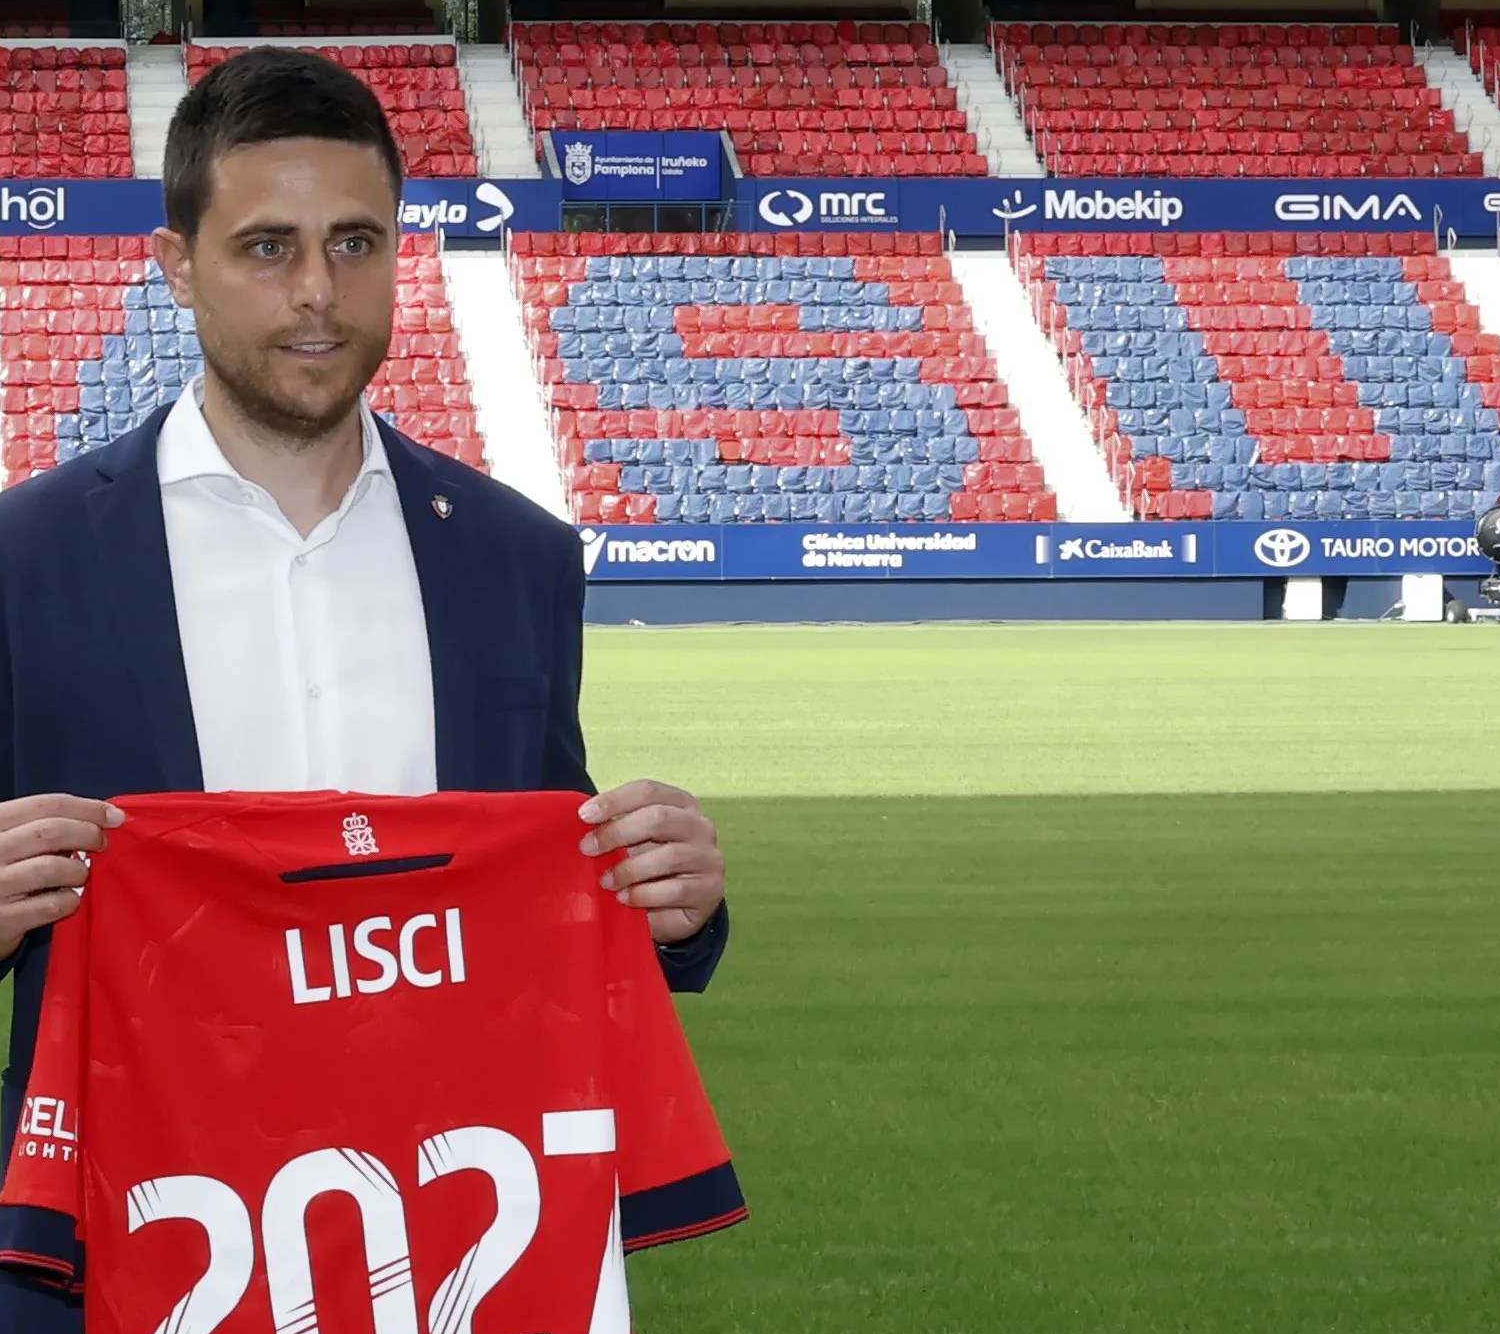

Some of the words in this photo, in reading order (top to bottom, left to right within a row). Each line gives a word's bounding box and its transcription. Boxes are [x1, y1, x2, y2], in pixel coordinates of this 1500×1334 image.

[595, 165, 654, 176] Pamplona
[662, 155, 707, 167] Iruñeko
[397, 199, 468, 228] aylo
[820, 192, 885, 214] mrc
[1045, 191, 1182, 225] Mobekip
[1275, 195, 1421, 221] GIMA
[607, 538, 715, 562] macron
[802, 533, 865, 551] Clínica
[866, 533, 977, 551] Universidad
[1085, 540, 1172, 558] CaixaBank
[1321, 537, 1394, 557] TAURO
[1400, 537, 1480, 557] MOTOR
[802, 551, 824, 568] de
[827, 552, 902, 568] Navarra
[285, 908, 466, 1005] LISCI
